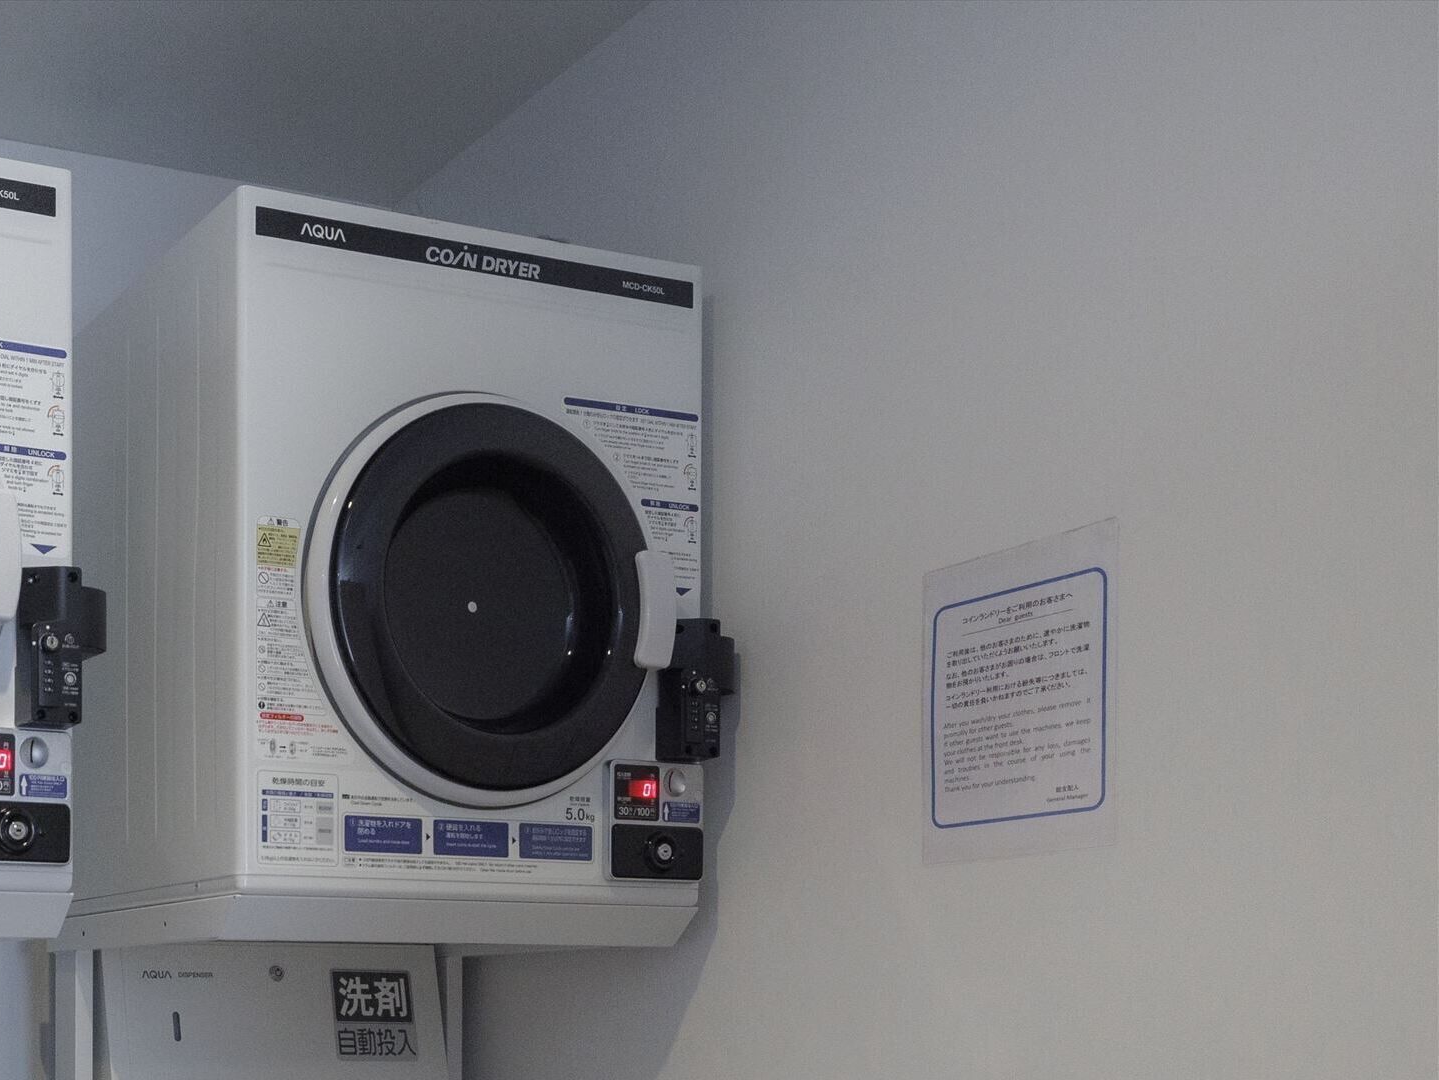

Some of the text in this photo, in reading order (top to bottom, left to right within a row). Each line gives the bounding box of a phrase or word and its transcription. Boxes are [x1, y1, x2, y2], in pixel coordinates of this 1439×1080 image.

[300, 222, 347, 243] AQUA
[425, 245, 541, 281] COIN DRYER
[622, 280, 666, 296] MCD-CK50L
[28, 449, 55, 459] UNLOCK
[962, 592, 1073, 624] コインランドリーをご利用のお客さまへ
[998, 611, 1033, 624] Dear guests
[970, 716, 996, 726] wash/dry
[1037, 705, 1056, 714] please
[1058, 701, 1081, 709] remove
[948, 739, 964, 747] other
[965, 737, 983, 745] guests
[1020, 727, 1030, 735] the
[1076, 717, 1091, 727] keep
[977, 725, 993, 733] other
[956, 747, 976, 755] clothes
[994, 741, 1008, 749] front
[1034, 745, 1044, 753] any
[993, 760, 1003, 768] the
[1007, 758, 1026, 766] course
[1040, 753, 1055, 761] your
[1058, 749, 1075, 759] using
[1080, 746, 1091, 754] the
[272, 776, 325, 788] 乾燥時間の目安
[944, 785, 960, 793] Thank
[981, 781, 994, 789] your
[642, 783, 651, 797] 0
[1065, 793, 1088, 801] Manager
[565, 808, 595, 823] 5.0kg
[141, 970, 214, 980] AQUA DISPENSER
[338, 977, 407, 1018] 洗剤
[337, 1028, 417, 1057] 自動投入
